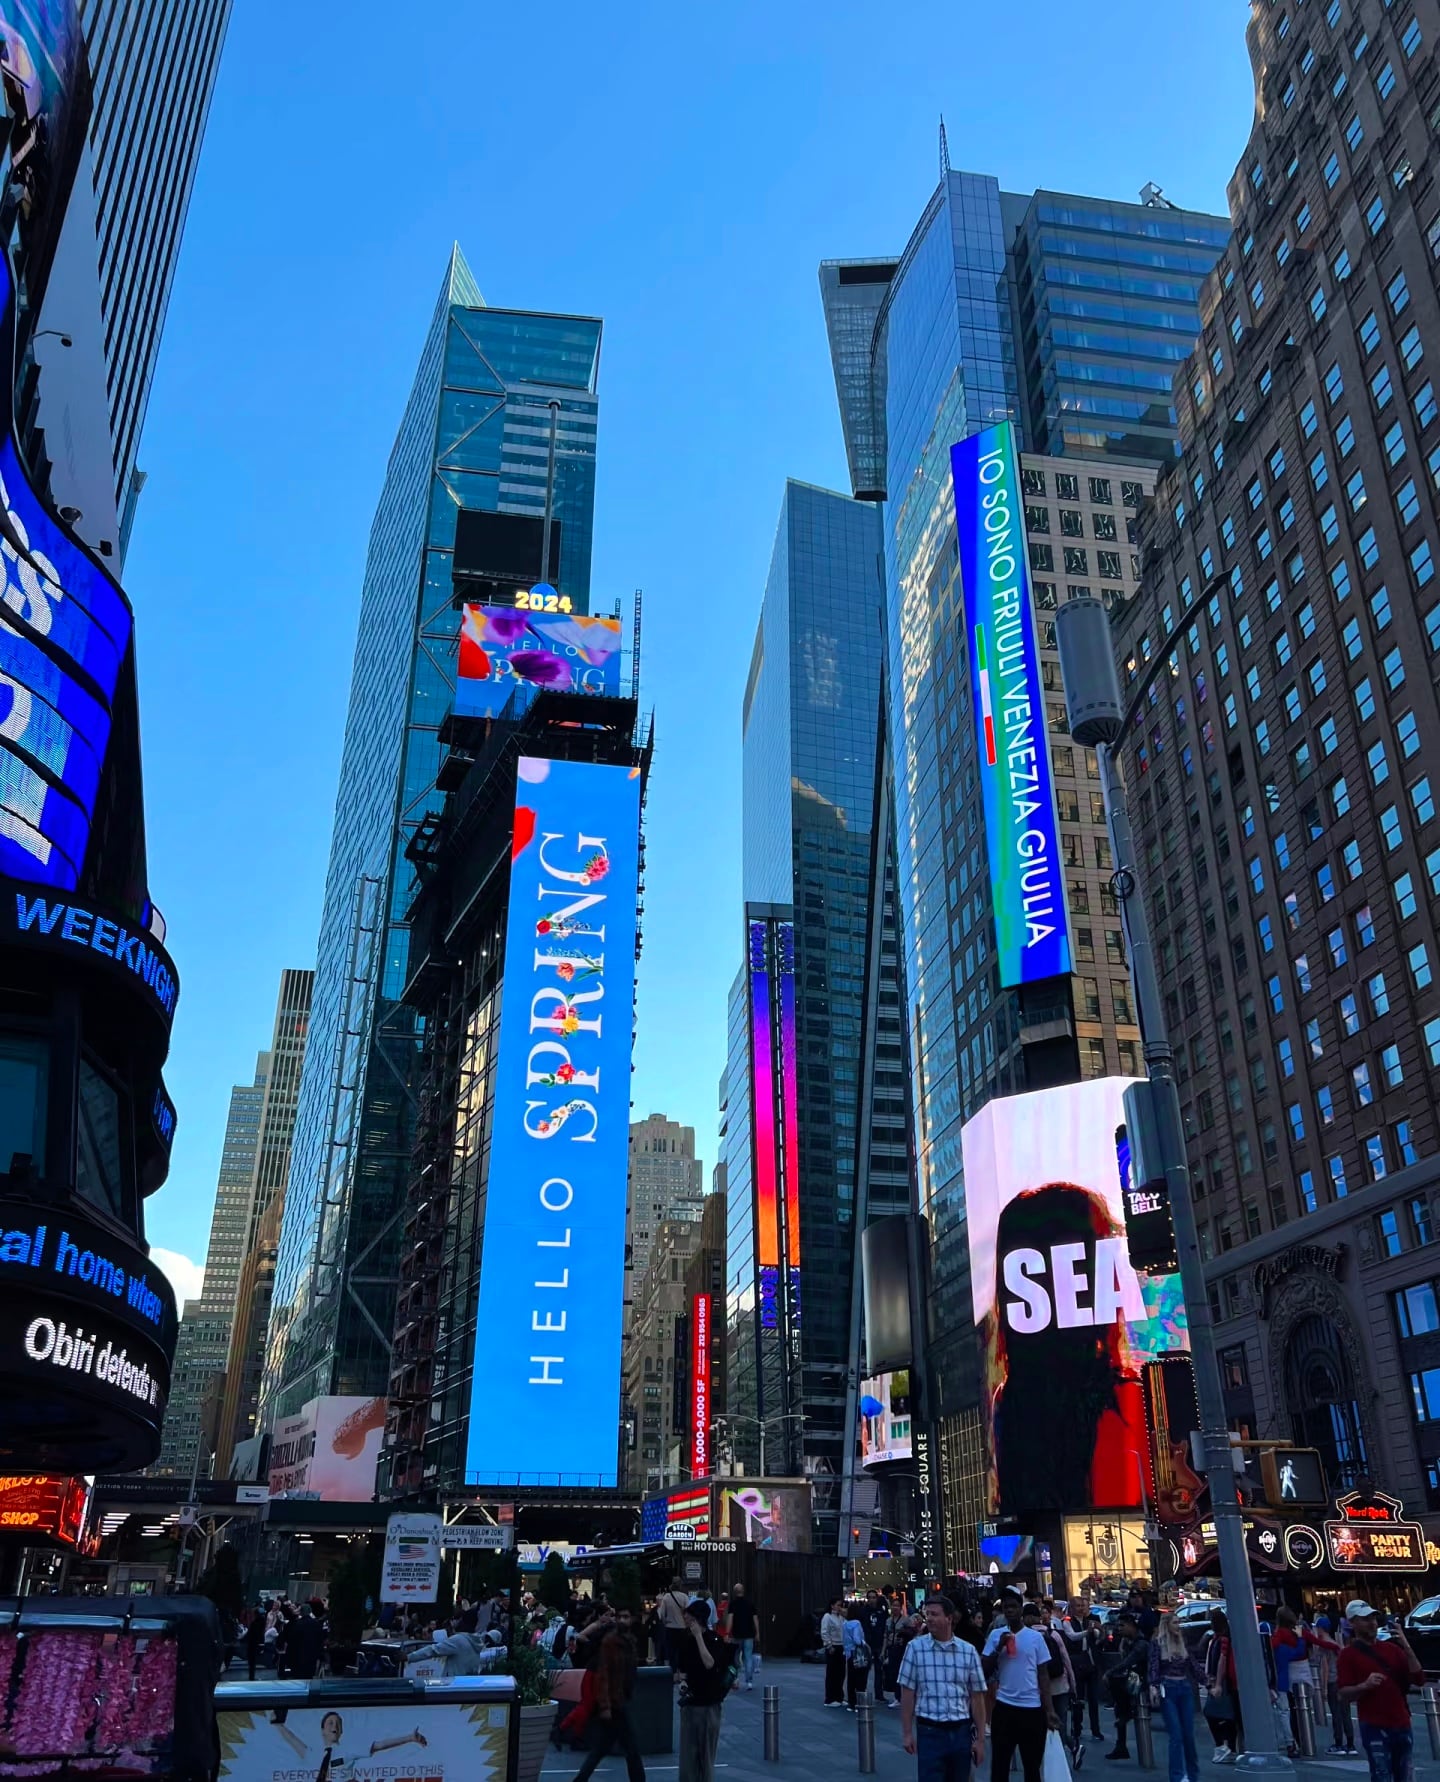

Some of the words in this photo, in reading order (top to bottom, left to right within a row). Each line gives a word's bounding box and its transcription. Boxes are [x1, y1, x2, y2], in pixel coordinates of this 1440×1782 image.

[977, 447, 1005, 485] IO
[982, 490, 1016, 582] SONO
[515, 591, 573, 614] 2024
[992, 586, 1027, 678] FRIULI
[1001, 679, 1042, 825] VENEZIA
[1016, 829, 1057, 949] GIULIA
[524, 832, 609, 1142] SPRING
[1131, 1199, 1163, 1215] BELL
[0, 1226, 47, 1267] al
[54, 1231, 125, 1297] home
[127, 1274, 163, 1325] where
[528, 1177, 574, 1385] HELLO
[761, 1270, 779, 1328] ROKU
[1002, 1237, 1149, 1334] SEA
[25, 1317, 97, 1374] Obiri
[95, 1341, 151, 1401] defends
[696, 1379, 706, 1394] SF
[695, 1395, 707, 1464] 3,000-9,000
[917, 1432, 930, 1495] SQUARE
[0, 1511, 39, 1525] SHOP
[667, 1531, 693, 1539] GARDEN
[983, 1522, 998, 1537] AT&T
[1346, 1506, 1367, 1517] Hard
[1367, 1506, 1389, 1520] Rock
[694, 1541, 737, 1552] HOTDOGS
[1370, 1534, 1411, 1547] PARTY
[1374, 1545, 1412, 1559] HOUR
[351, 1765, 398, 1779] INVITED
[400, 1765, 418, 1777] TO
[420, 1764, 444, 1776] THIS
